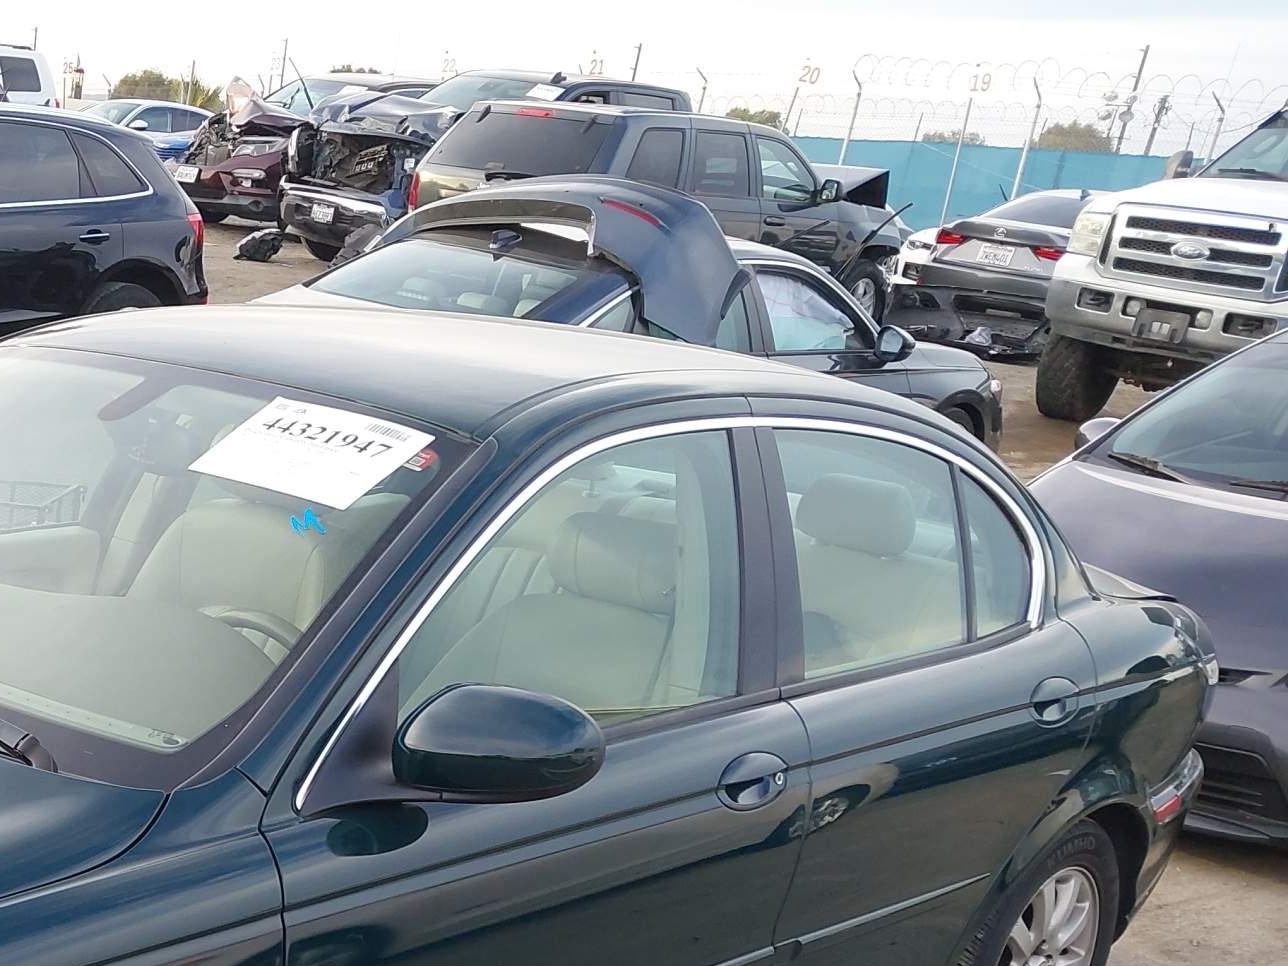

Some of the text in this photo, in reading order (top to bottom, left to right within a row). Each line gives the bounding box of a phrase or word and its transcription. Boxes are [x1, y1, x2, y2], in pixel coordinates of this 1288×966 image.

[442, 58, 457, 72] 22
[589, 59, 604, 75] 21
[798, 65, 821, 85] 20
[969, 72, 992, 92] 19
[262, 417, 393, 458] 44321947
[1047, 835, 1096, 869] KUMHO
